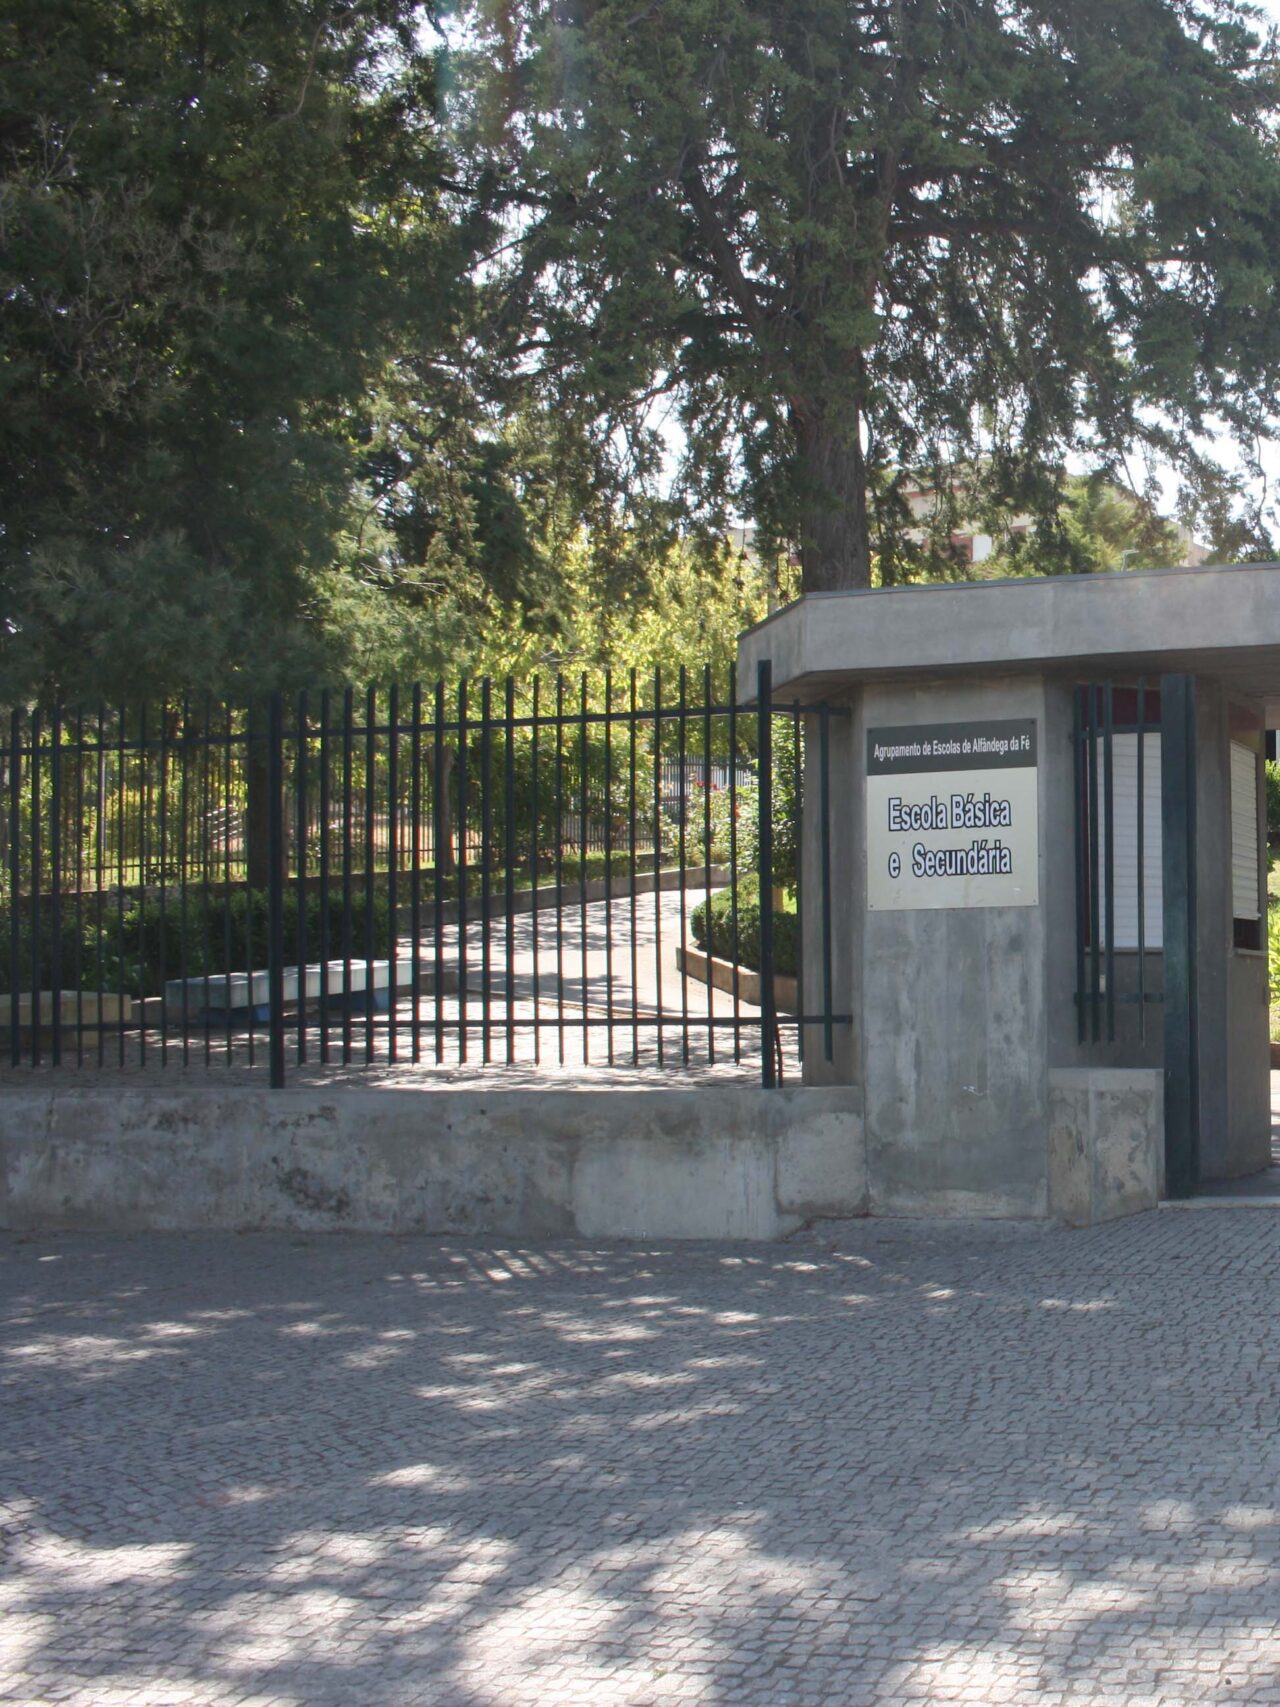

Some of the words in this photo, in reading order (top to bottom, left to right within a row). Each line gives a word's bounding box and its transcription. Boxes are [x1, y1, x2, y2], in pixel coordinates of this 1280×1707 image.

[874, 742, 921, 761] Agrupamento
[922, 740, 932, 755] de
[933, 739, 961, 755] Escolas
[962, 738, 972, 753] de
[973, 737, 1009, 755] Alfândega
[1010, 736, 1019, 750] da
[1020, 735, 1030, 750] Fé
[888, 795, 948, 832] Escola
[950, 793, 1012, 829] Básica
[888, 851, 901, 879] e
[912, 839, 1013, 878] Secundária
